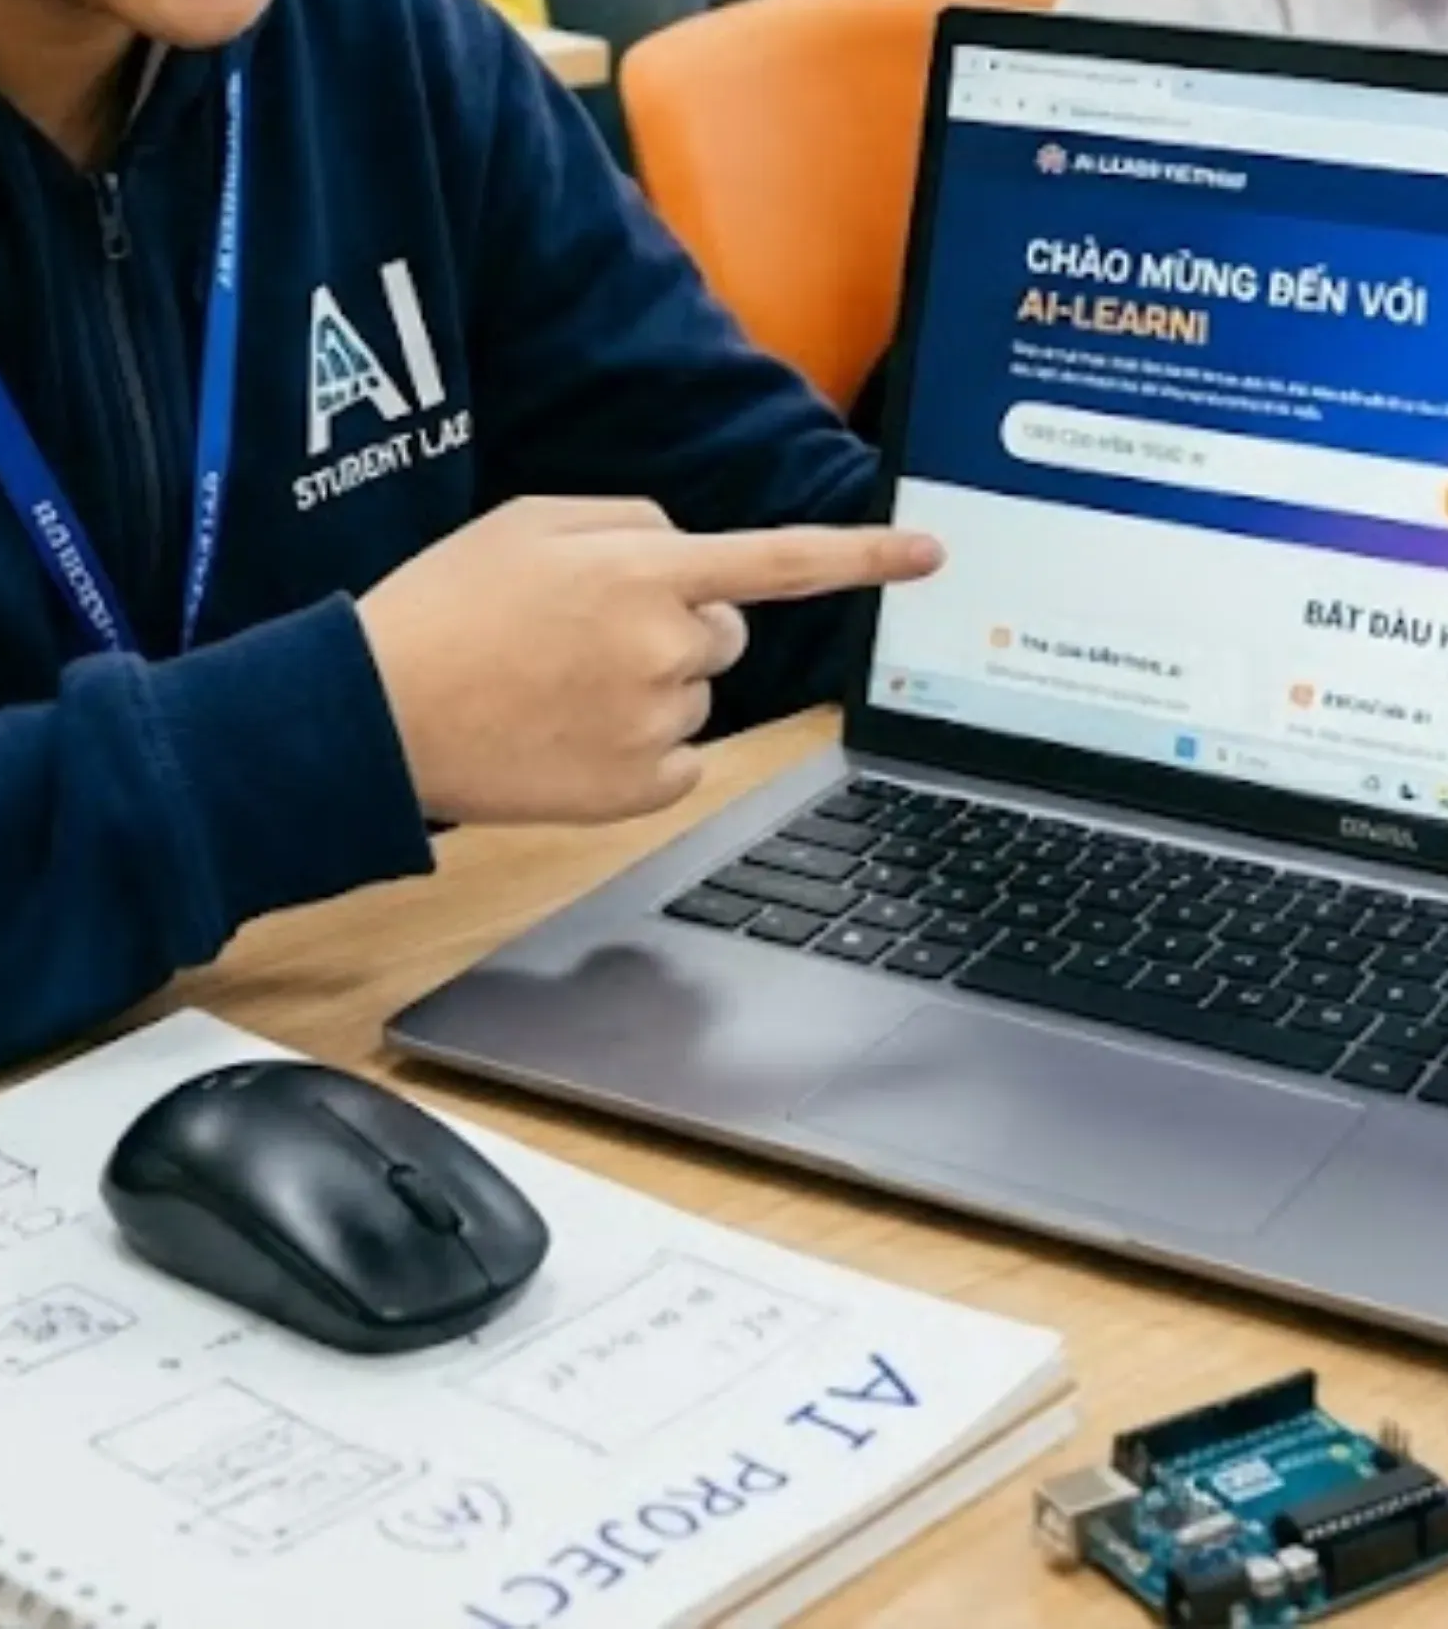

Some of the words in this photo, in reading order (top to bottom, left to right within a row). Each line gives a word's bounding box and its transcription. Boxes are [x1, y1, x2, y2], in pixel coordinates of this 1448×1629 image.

[1027, 234, 1130, 285] CHÀO
[1139, 250, 1259, 302] MỪNG
[1359, 278, 1427, 325] VỚI
[307, 259, 446, 457] AI
[787, 1354, 918, 1449] AI
